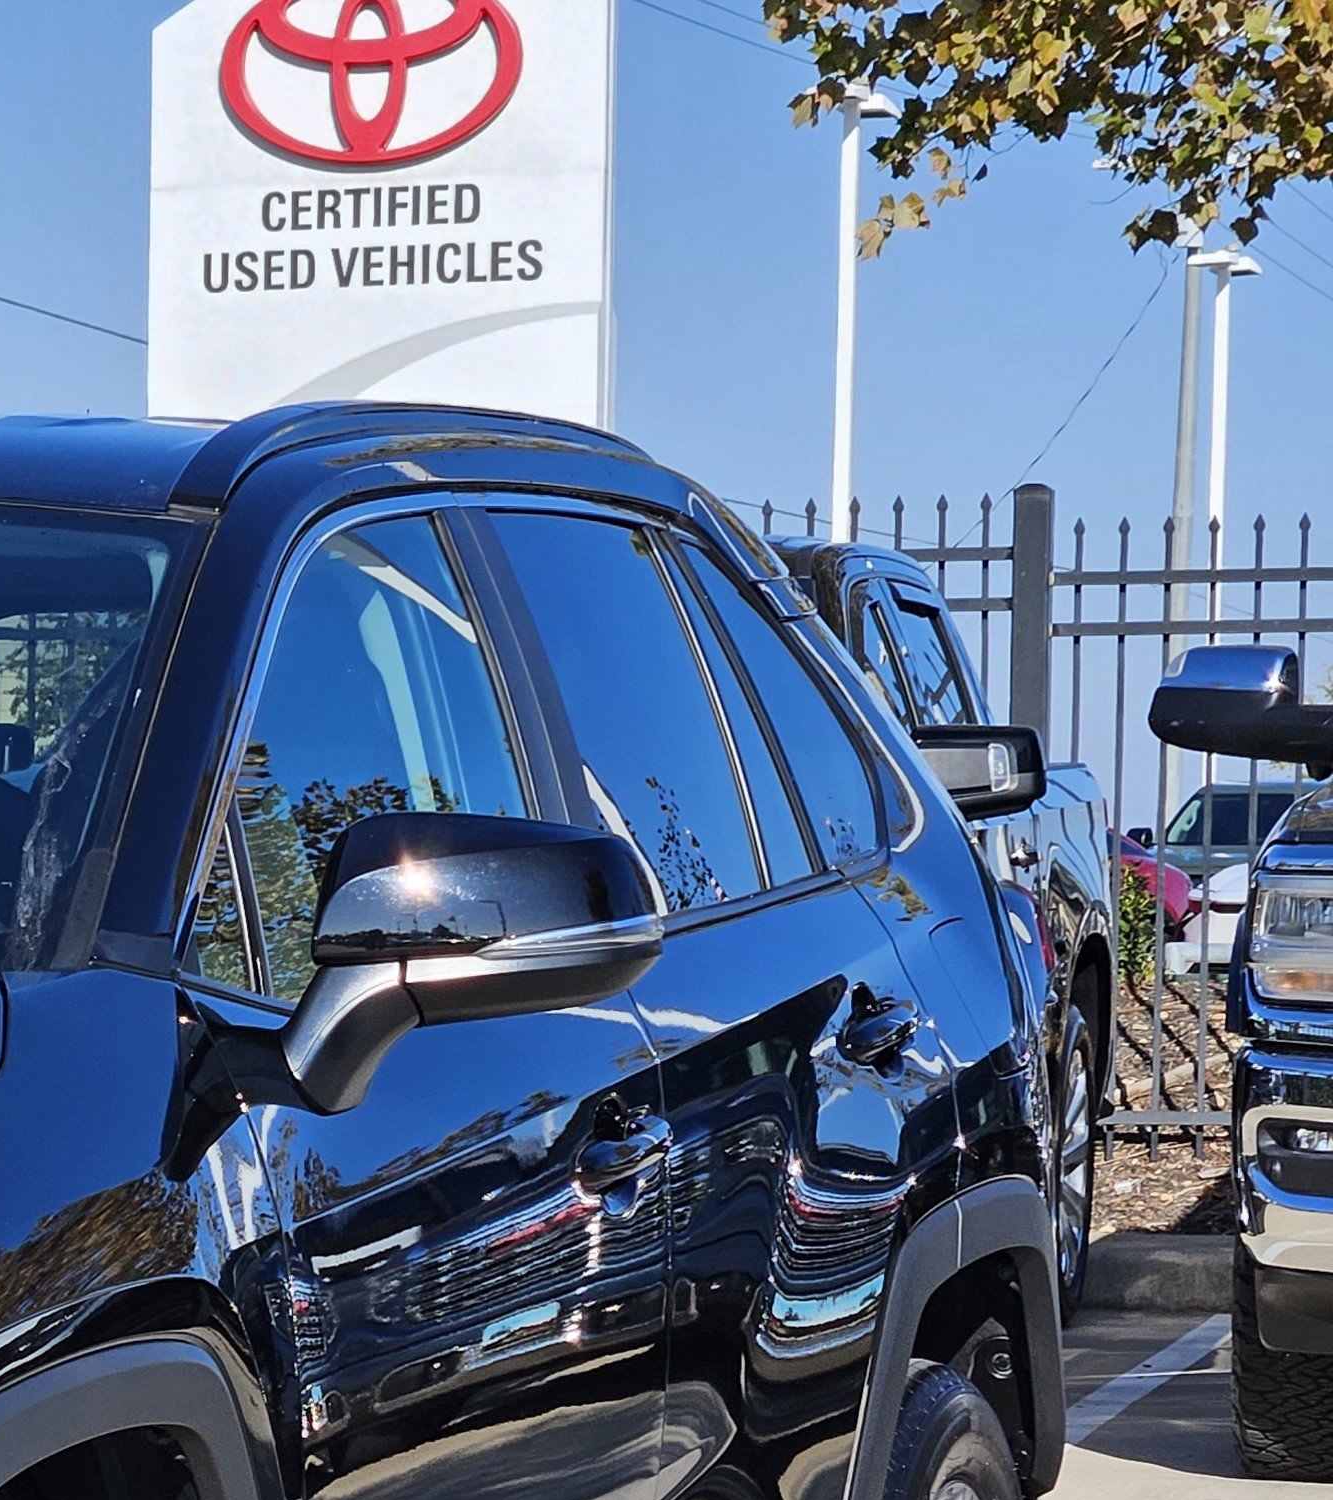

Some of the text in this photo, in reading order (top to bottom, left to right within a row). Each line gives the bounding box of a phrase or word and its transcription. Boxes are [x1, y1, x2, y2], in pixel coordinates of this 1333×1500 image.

[261, 183, 481, 232] CERTIFIED
[203, 239, 544, 293] USED VEHICLES
